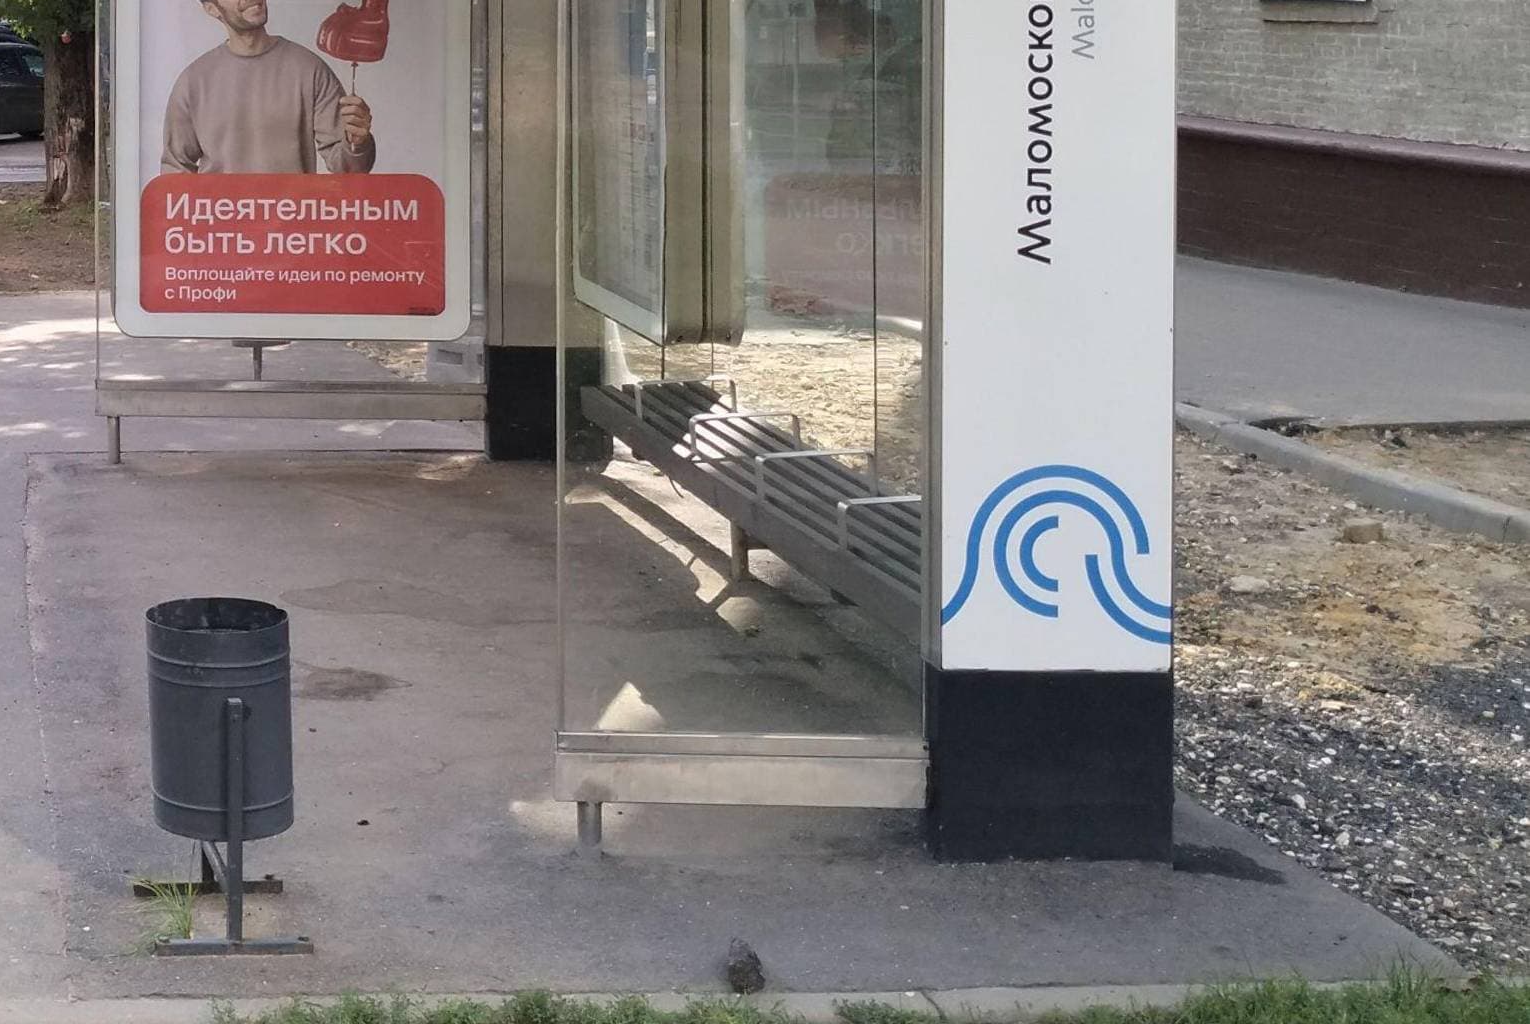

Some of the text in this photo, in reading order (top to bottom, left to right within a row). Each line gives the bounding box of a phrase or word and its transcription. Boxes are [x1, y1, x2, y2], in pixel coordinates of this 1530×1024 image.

[165, 192, 419, 225] Идеятельным
[165, 226, 368, 255] быть легко
[165, 267, 425, 284] Воплощайте идеи по ремонту
[165, 286, 237, 303] с Профи
